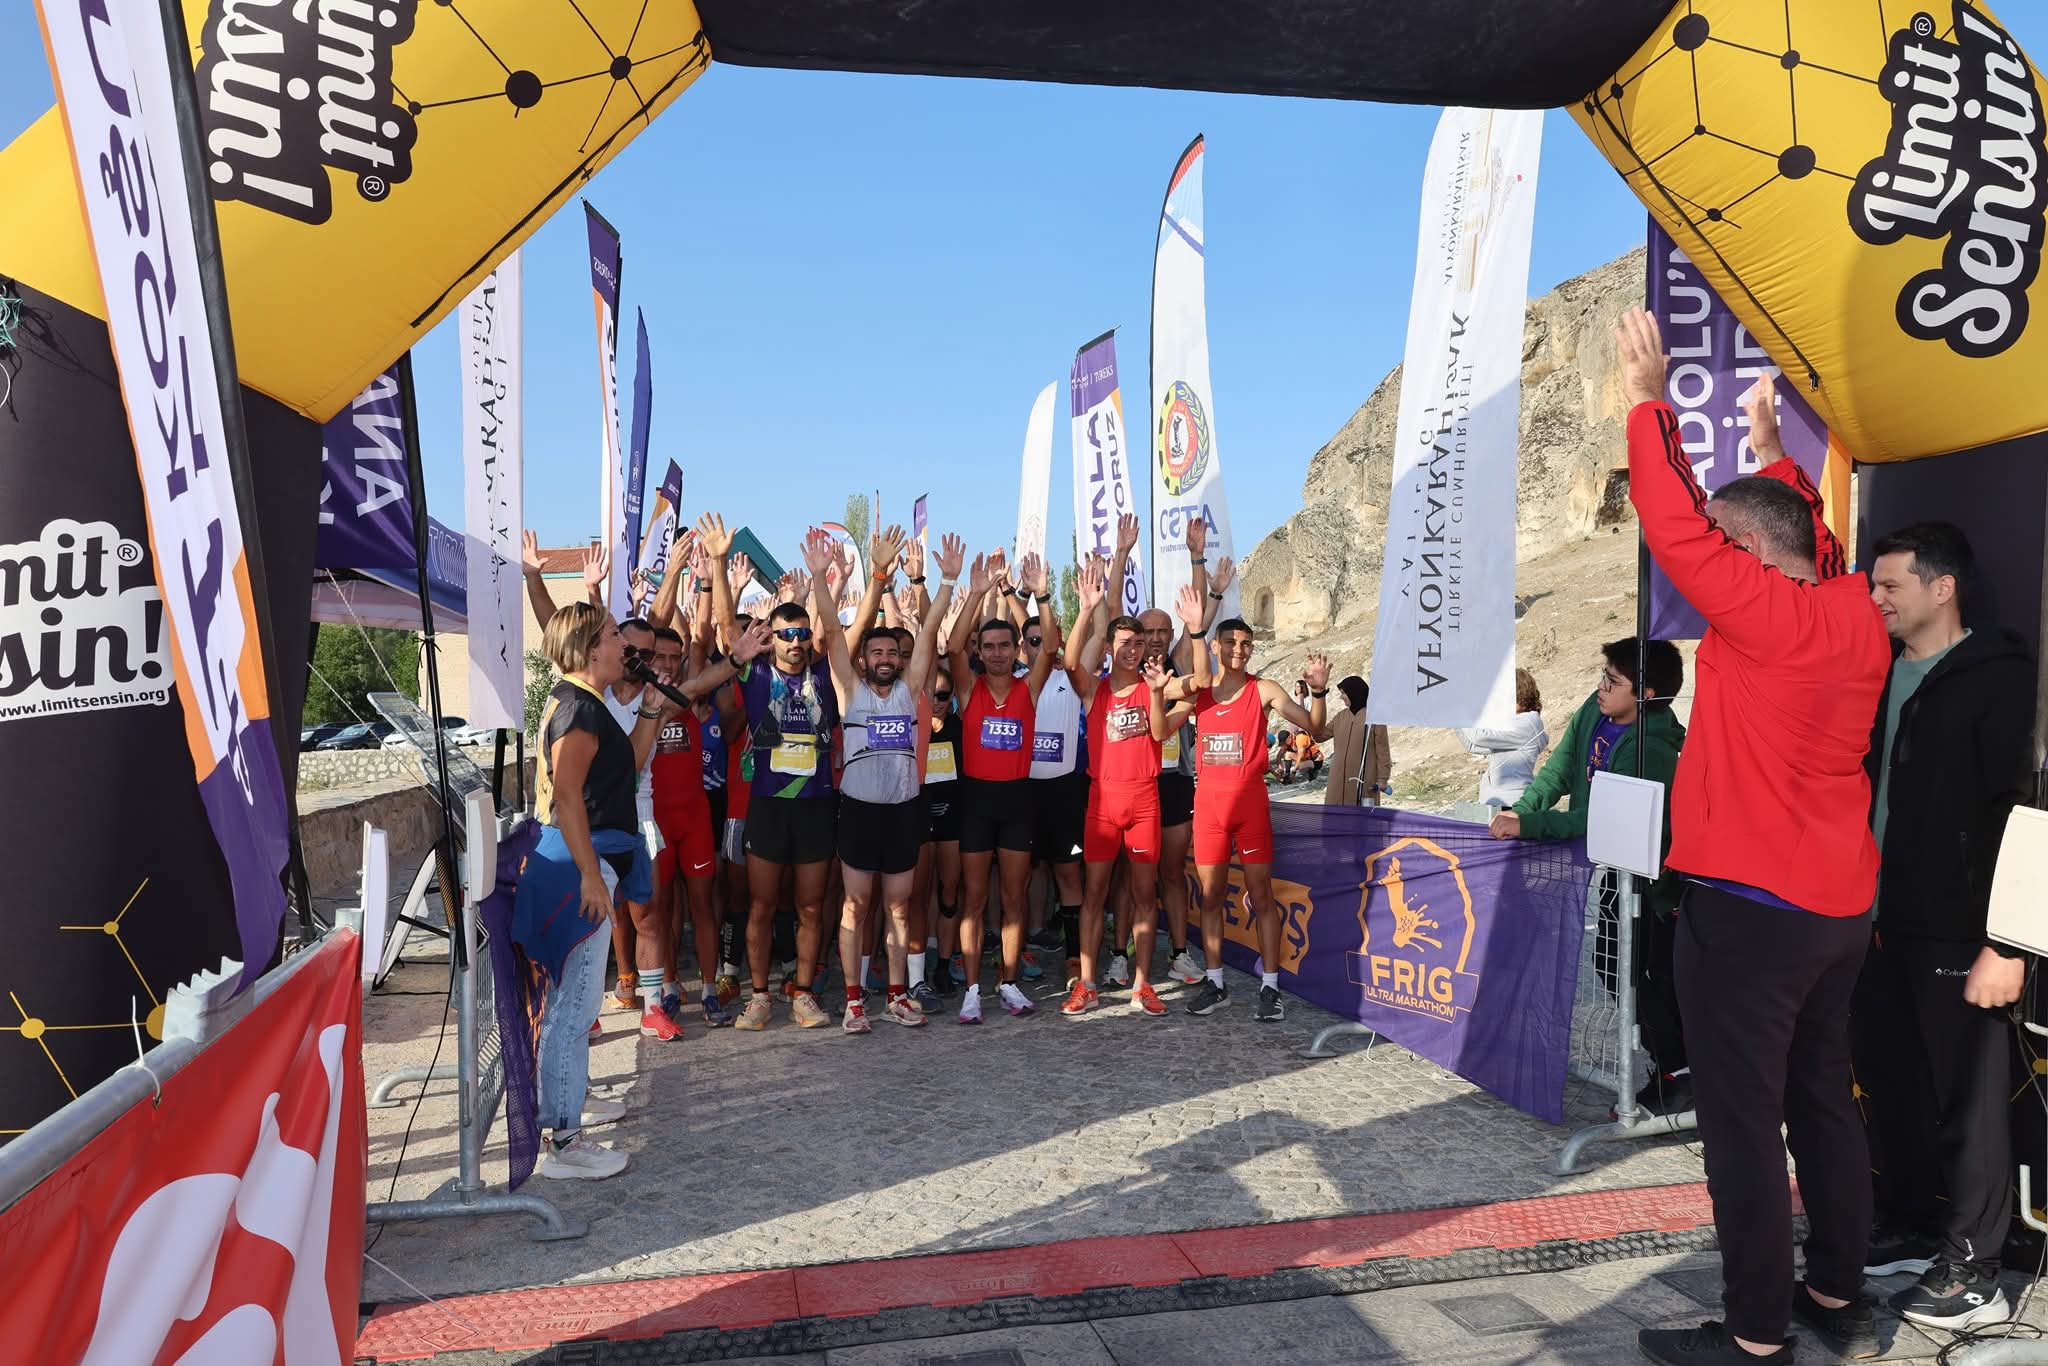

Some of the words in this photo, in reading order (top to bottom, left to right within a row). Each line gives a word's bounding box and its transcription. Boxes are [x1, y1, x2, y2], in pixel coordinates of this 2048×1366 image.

[1912, 10, 2038, 345] Sensin!
[1112, 712, 1140, 727] 1012
[875, 722, 905, 734] 1226
[989, 723, 1018, 736] 1333
[1209, 740, 1234, 751] 1011
[1370, 955, 1453, 1004] FRIG
[1366, 985, 1395, 1003] ULTRA
[1395, 994, 1454, 1018] MARATHON
